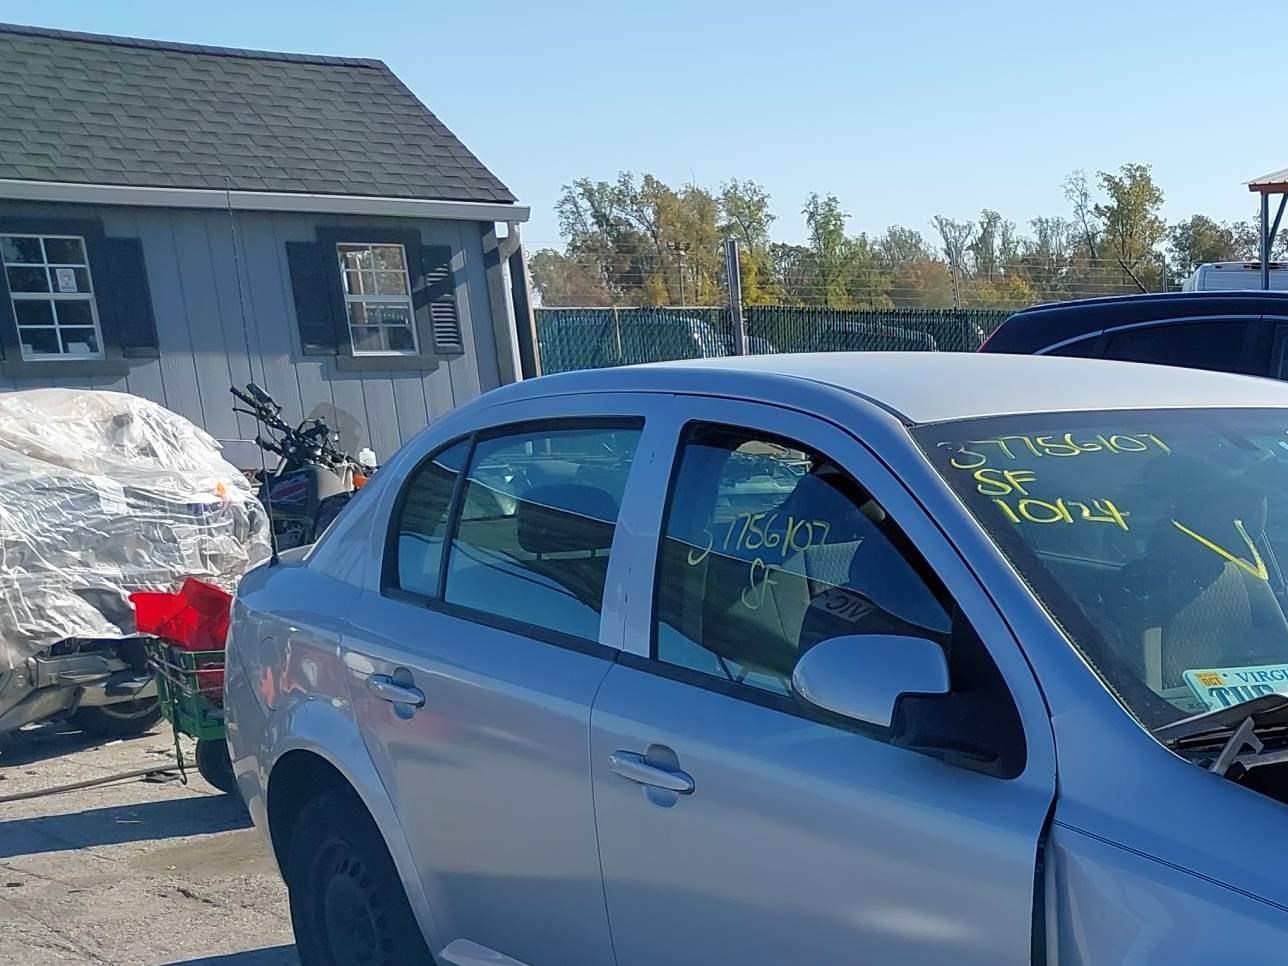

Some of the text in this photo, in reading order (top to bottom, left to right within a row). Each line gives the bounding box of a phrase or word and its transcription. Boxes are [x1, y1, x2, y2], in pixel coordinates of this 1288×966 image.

[937, 433, 1172, 469] 37756107
[974, 468, 1037, 496] SF
[741, 557, 782, 610] SF
